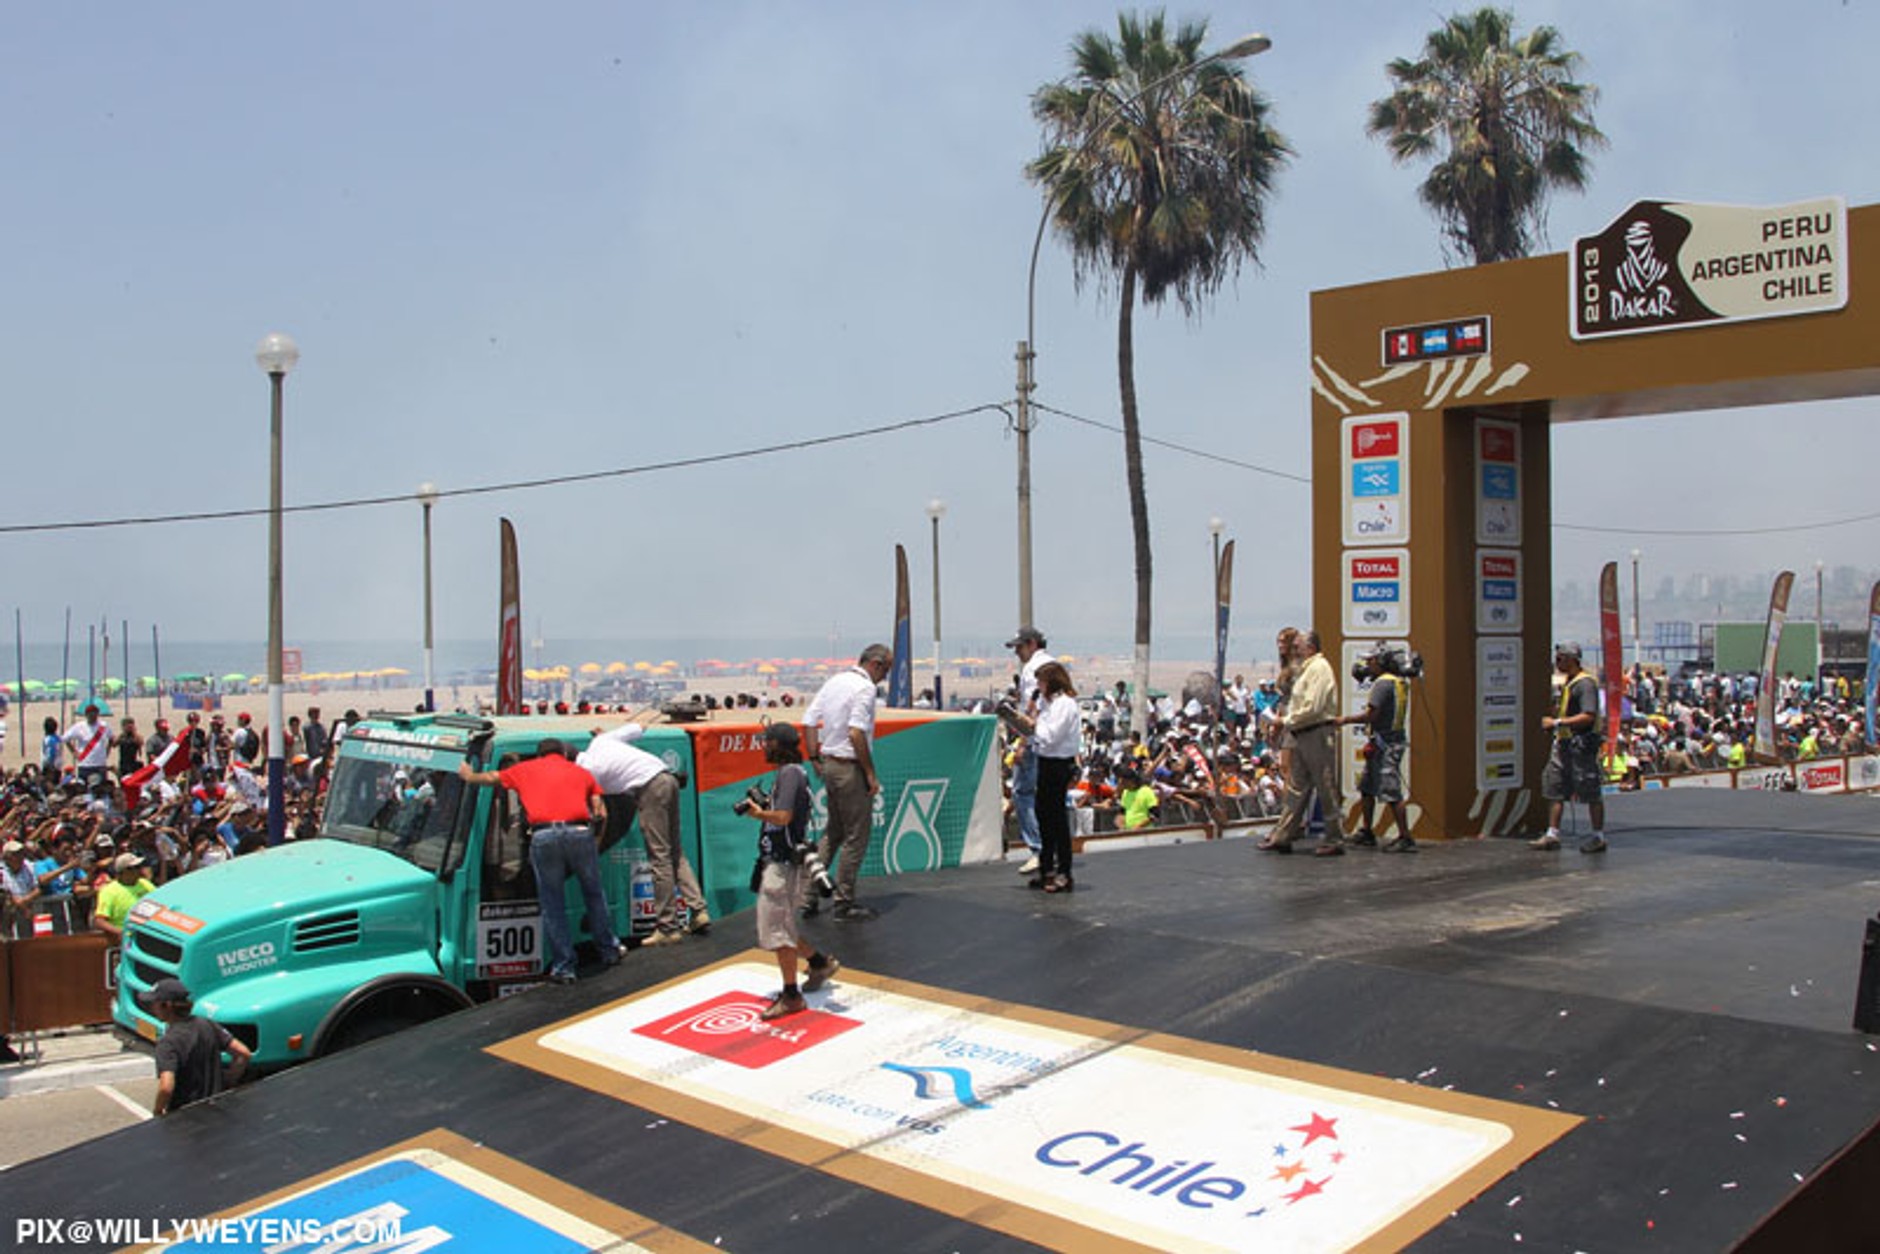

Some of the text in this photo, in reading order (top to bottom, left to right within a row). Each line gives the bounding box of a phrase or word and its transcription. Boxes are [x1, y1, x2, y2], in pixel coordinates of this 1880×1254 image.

[1762, 212, 1833, 243] PERU
[1691, 243, 1833, 282] ARGENTINA
[1583, 247, 1600, 323] 2013
[1763, 272, 1834, 301] CHILE
[1609, 285, 1676, 321] DAKAR
[1357, 520, 1386, 534] Chile
[1356, 562, 1397, 574] TOTAL
[1356, 585, 1395, 599] Macro
[719, 734, 747, 753] DE
[216, 941, 275, 967] IVECO
[486, 924, 535, 959] 500
[928, 1034, 1057, 1077] Argentina
[896, 1114, 947, 1135] vos
[1035, 1130, 1247, 1208] Chile
